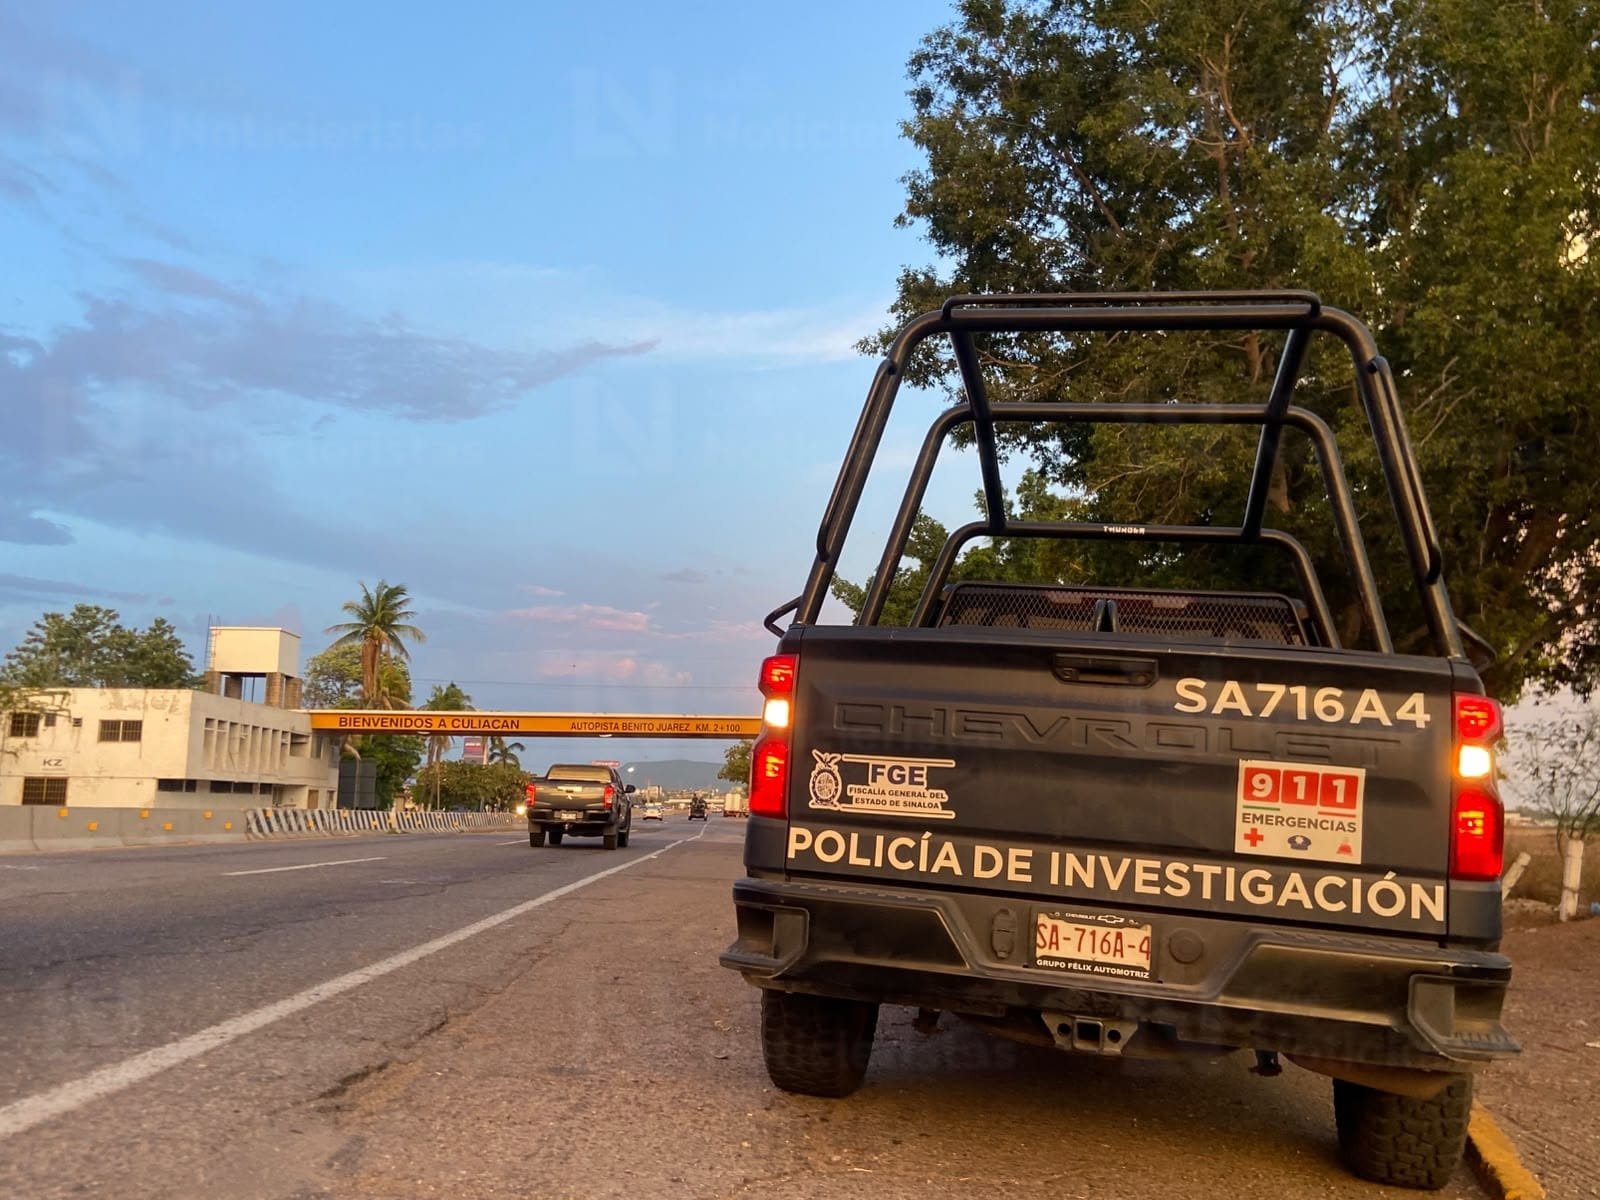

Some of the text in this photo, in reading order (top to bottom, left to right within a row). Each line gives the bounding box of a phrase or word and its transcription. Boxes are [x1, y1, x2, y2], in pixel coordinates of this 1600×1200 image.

[1103, 526, 1145, 535] THUNDER
[1174, 677, 1431, 729] SA716A4
[339, 717, 520, 730] BIENVENIDOS A CULIACAN
[571, 721, 619, 731] AUTOPISTA
[622, 722, 654, 732] BENITO
[656, 722, 690, 732] JUAREZ
[713, 723, 741, 733] 2+100
[833, 702, 1401, 769] CHEVROLET
[871, 764, 925, 786] FGE
[849, 786, 886, 796] FISCALÍA
[888, 790, 927, 798] GENERAL
[855, 798, 887, 806] ESTADO
[902, 800, 940, 809] SINALOA
[1242, 813, 1357, 833] EMERGENCIAS
[787, 827, 1445, 922] POLICÍA DE INVESTIGACIÓN
[1036, 923, 1151, 960] SA-716A-4
[1036, 959, 1150, 979] GRUPO FÉLIX AUTOMOTRIZ
